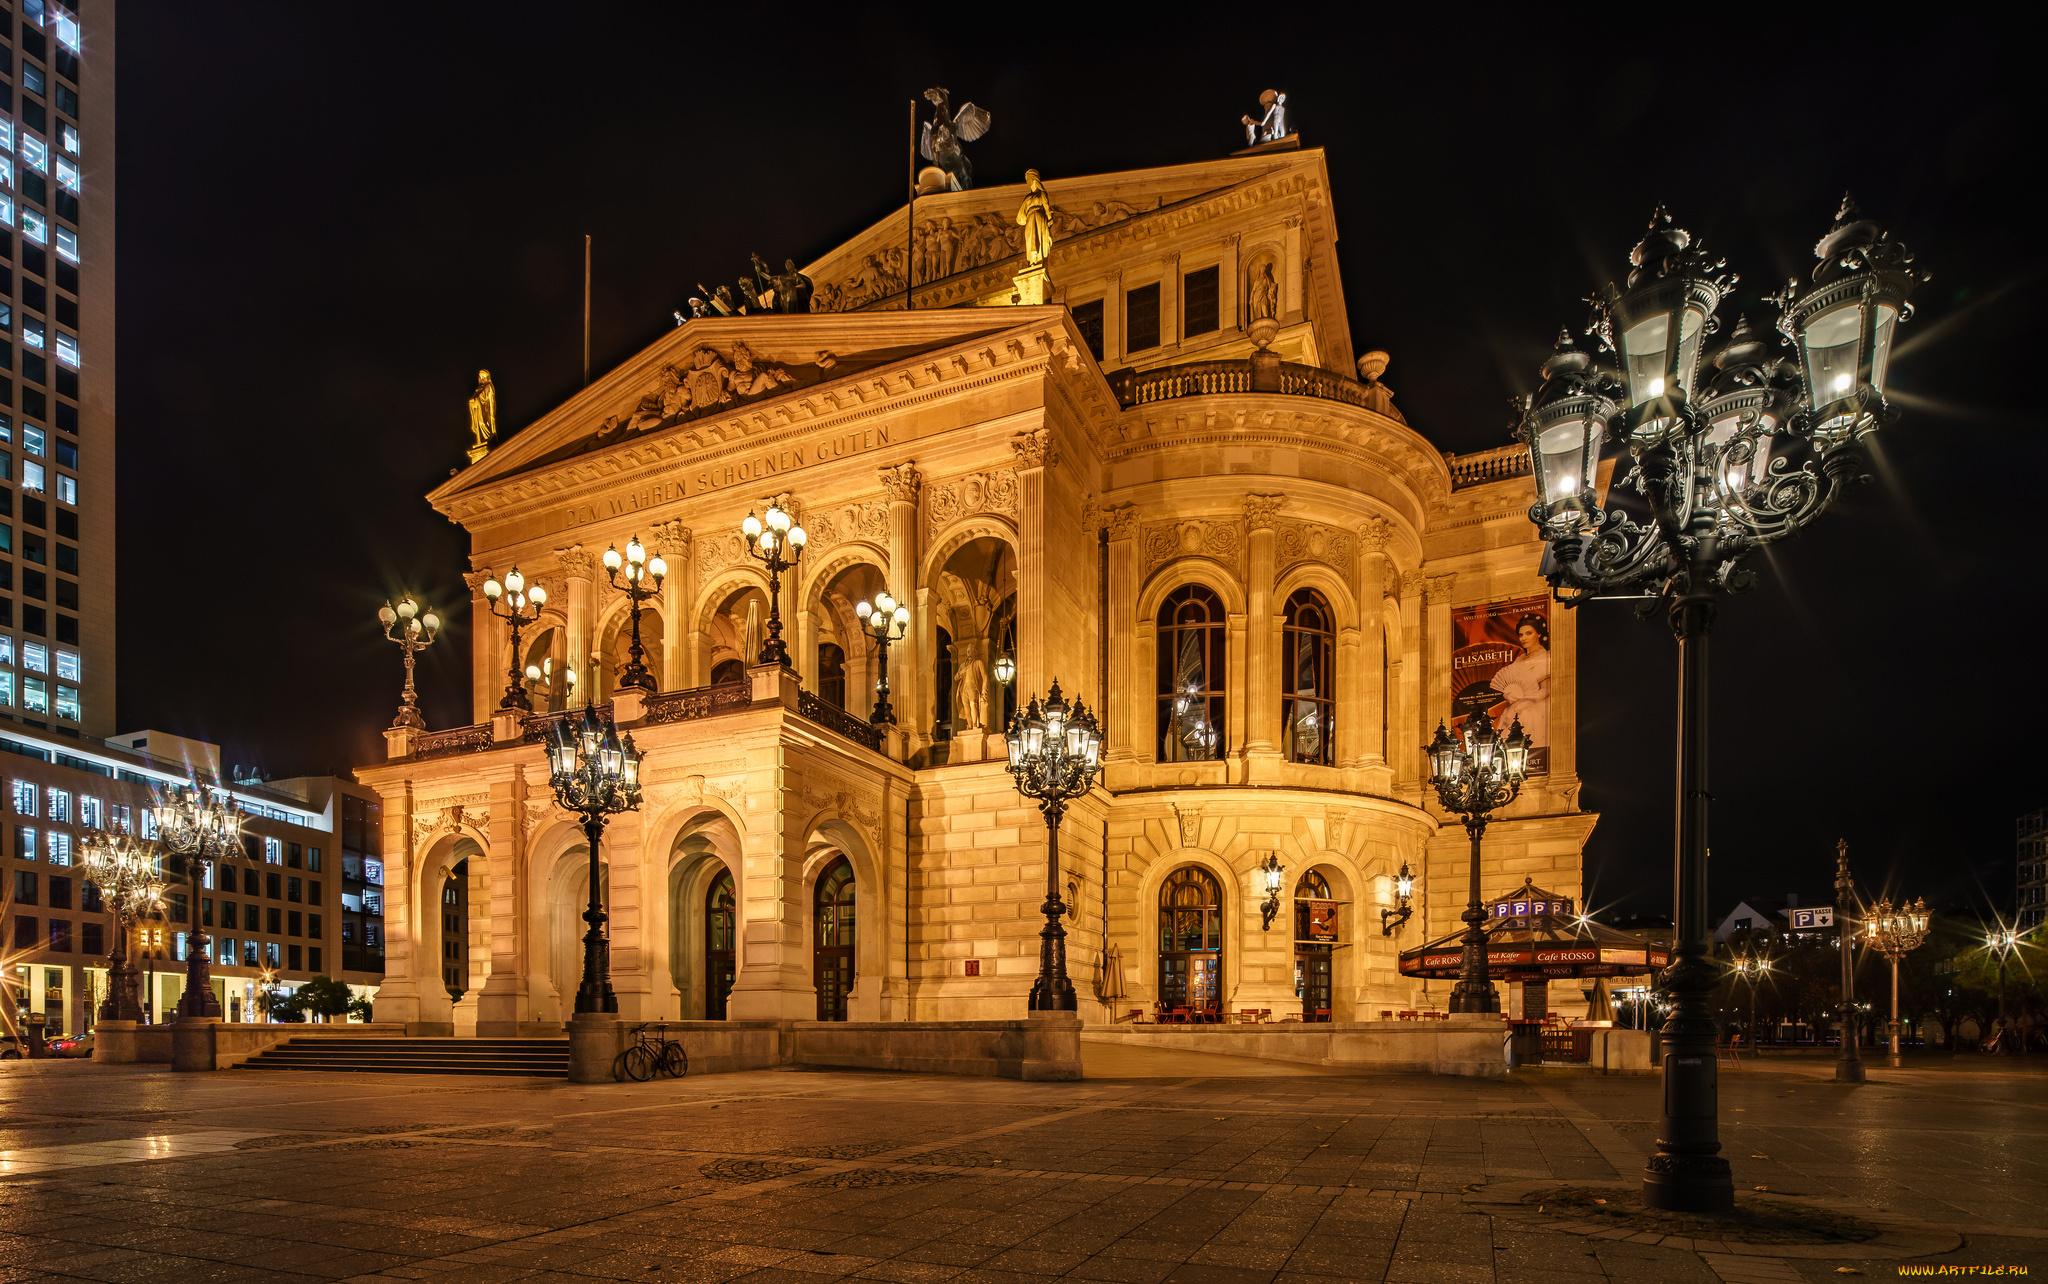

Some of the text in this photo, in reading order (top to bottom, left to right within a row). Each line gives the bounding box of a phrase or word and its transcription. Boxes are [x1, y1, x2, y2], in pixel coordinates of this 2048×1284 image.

[609, 479, 686, 515] WAHREN
[697, 447, 804, 490] SCHOENEN
[1512, 604, 1545, 614] FRANKFURT
[1454, 650, 1513, 669] ELISABETH
[1499, 906, 1507, 917] P
[1515, 904, 1525, 916] P
[1534, 904, 1544, 915] P
[1553, 904, 1561, 915] P
[1441, 956, 1461, 965] ROSS
[1537, 951, 1595, 963] Café ROSSO
[1621, 976, 1643, 984] Opera
